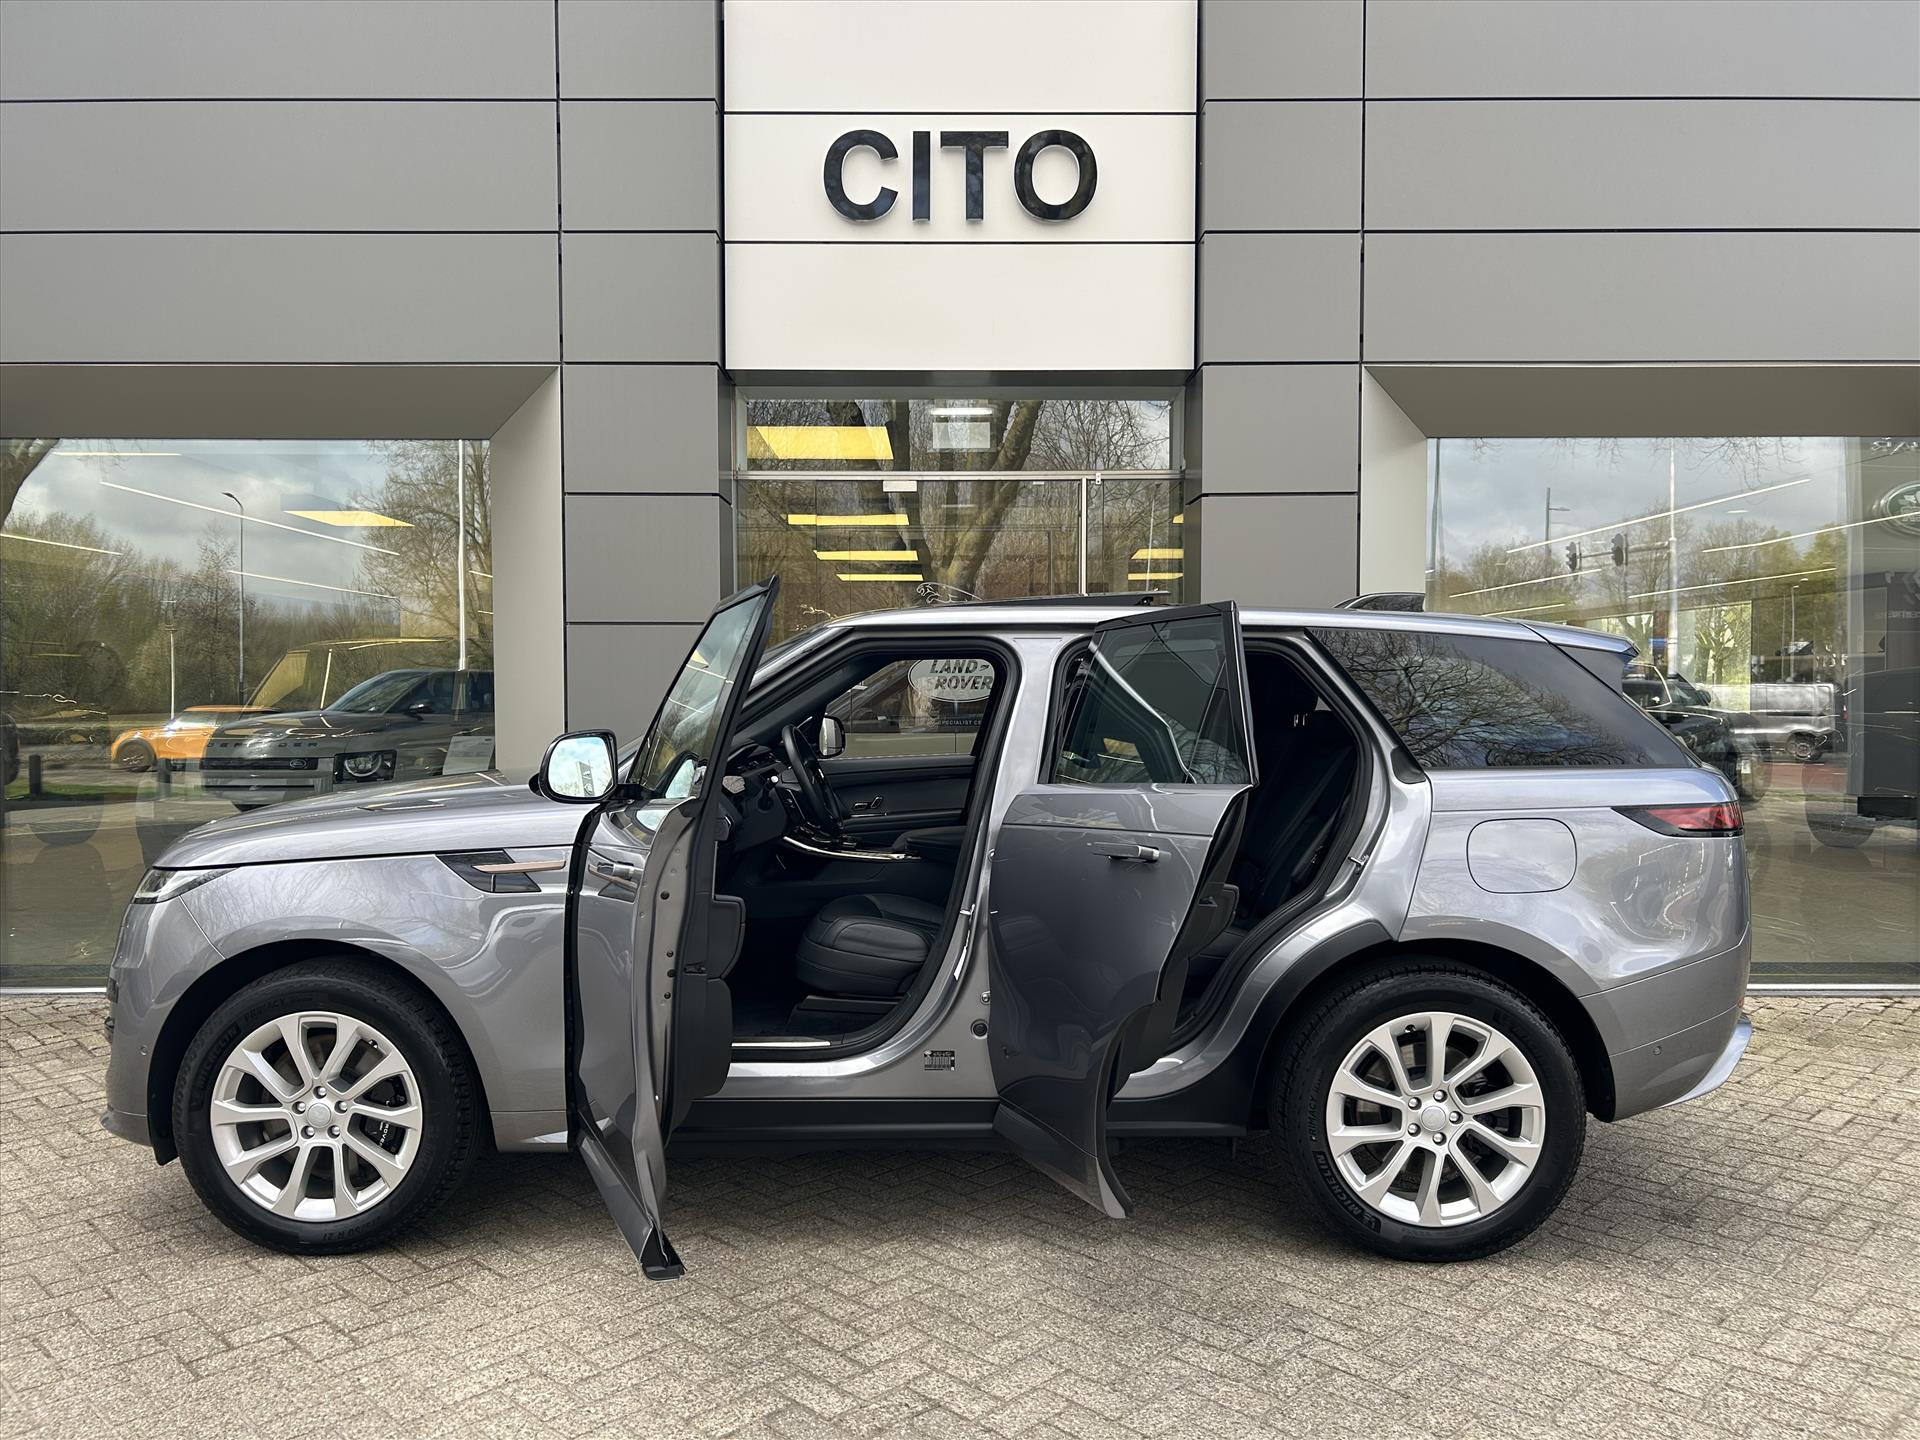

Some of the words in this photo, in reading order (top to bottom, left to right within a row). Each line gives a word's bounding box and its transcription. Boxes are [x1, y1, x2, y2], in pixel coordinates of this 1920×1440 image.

[823, 129, 1098, 222] CITO
[929, 659, 978, 674] LAND
[934, 675, 994, 690] ROVER
[1316, 1154, 1362, 1215] MICHELIN
